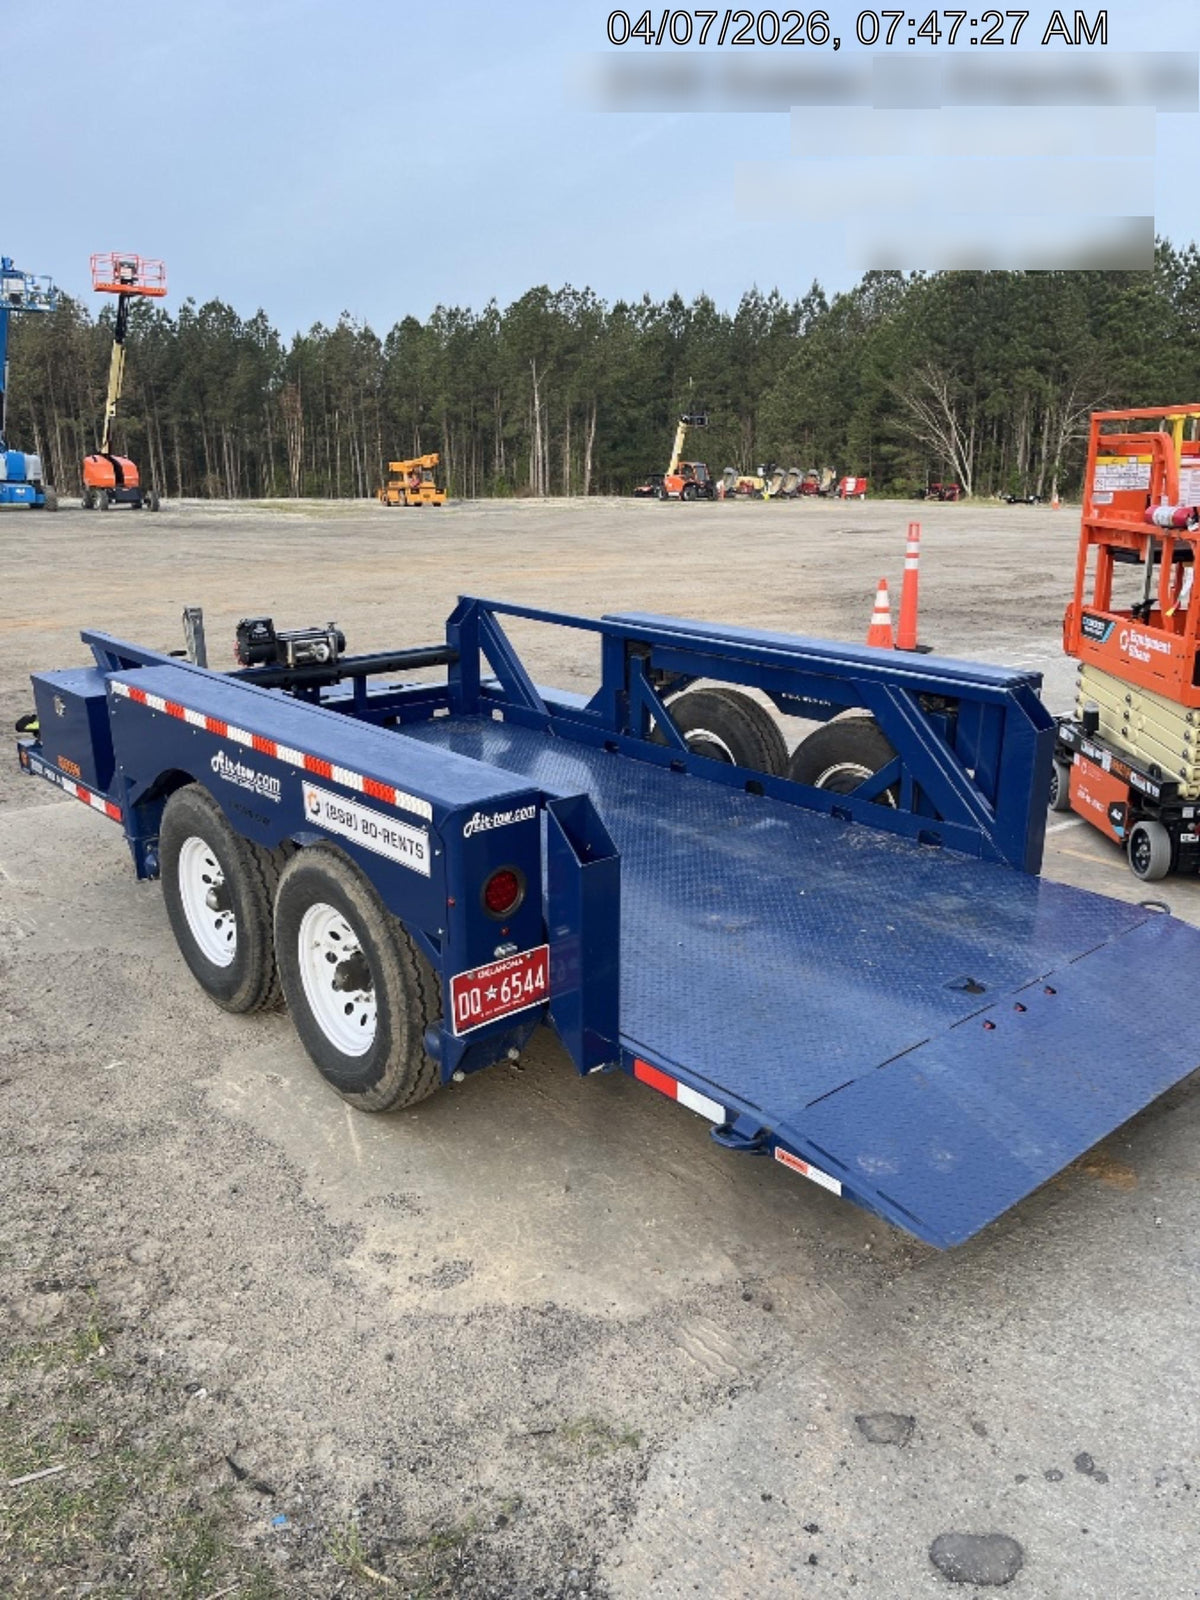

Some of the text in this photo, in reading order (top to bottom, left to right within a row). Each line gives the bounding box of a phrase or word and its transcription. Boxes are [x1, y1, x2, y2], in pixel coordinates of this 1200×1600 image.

[361, 818, 425, 860] 80-RENTS
[477, 958, 524, 979] OKLAHOMA
[500, 964, 545, 1004] 6544
